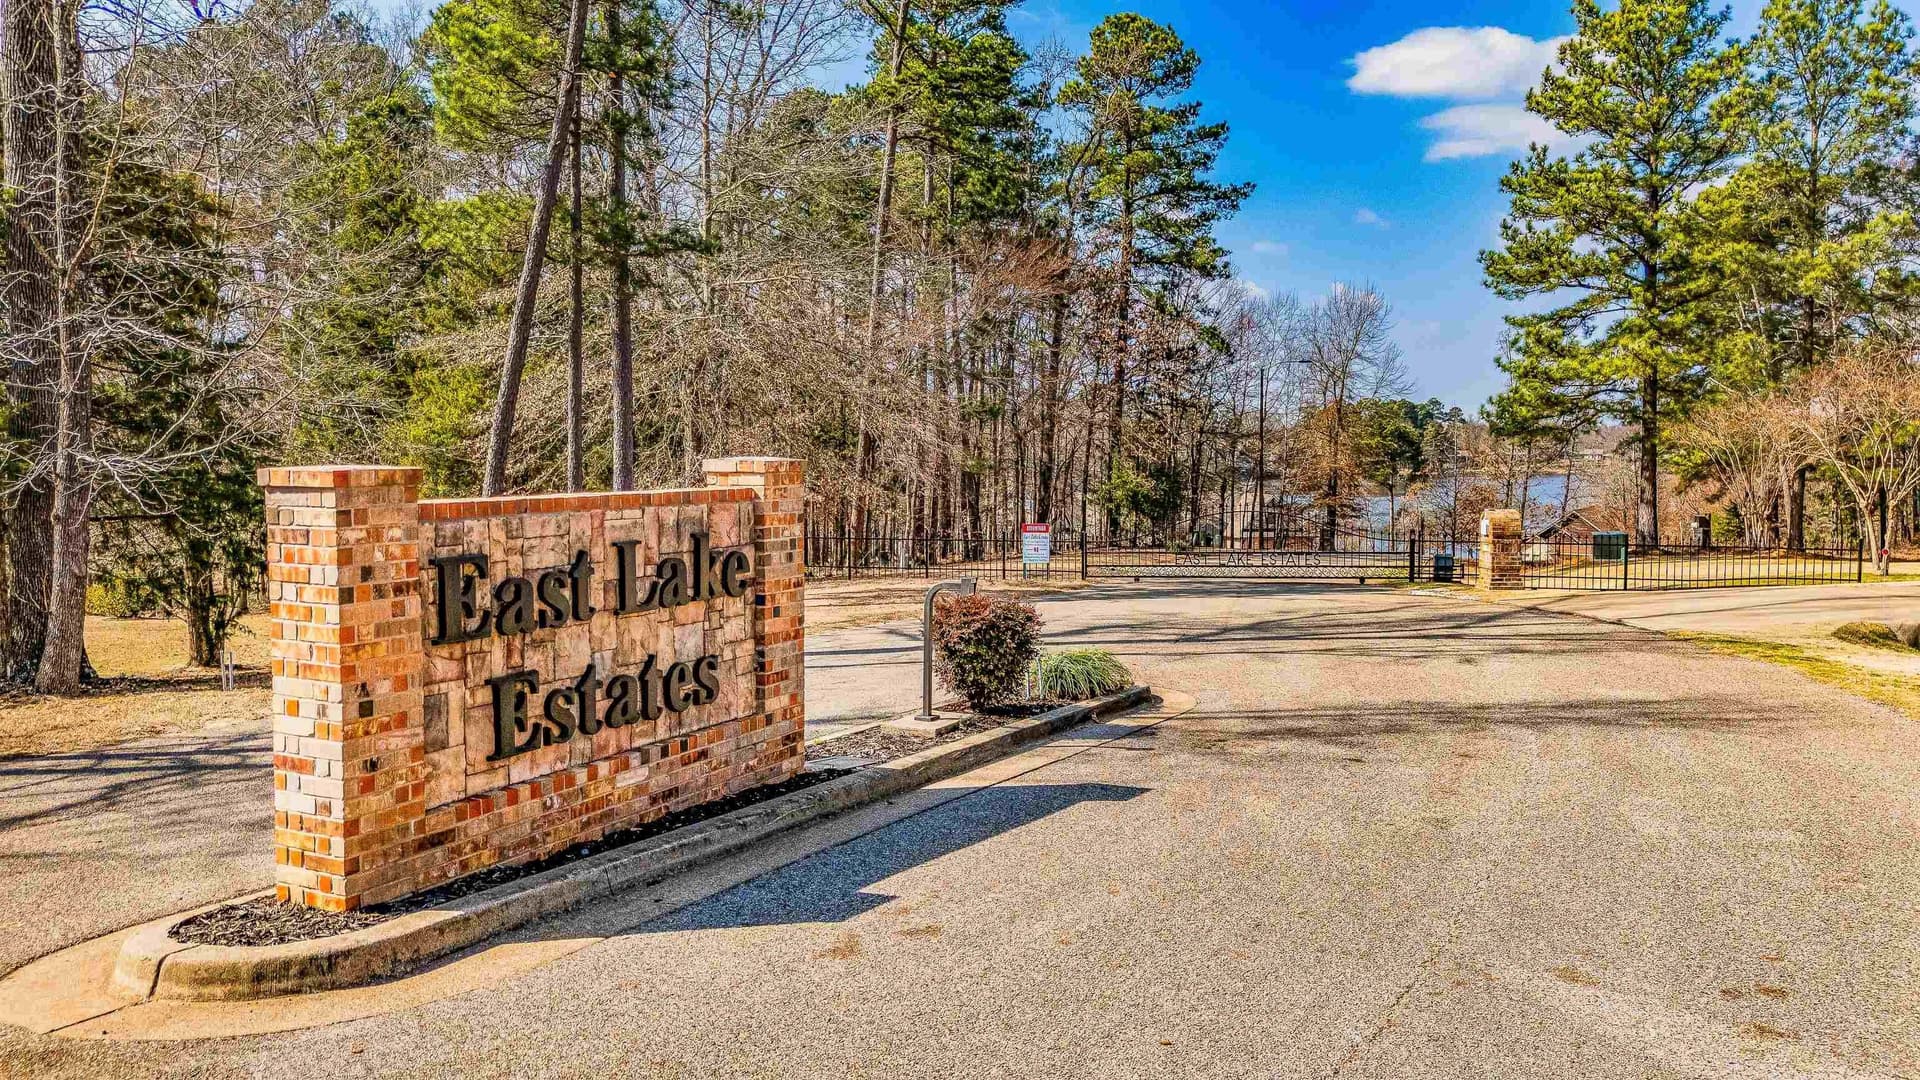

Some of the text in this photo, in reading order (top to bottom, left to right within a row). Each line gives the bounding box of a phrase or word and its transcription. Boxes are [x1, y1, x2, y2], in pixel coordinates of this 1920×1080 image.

[429, 532, 750, 646] East Lake
[1175, 552, 1321, 566] EAST LAKE ESTATES
[486, 654, 720, 761] Estates
